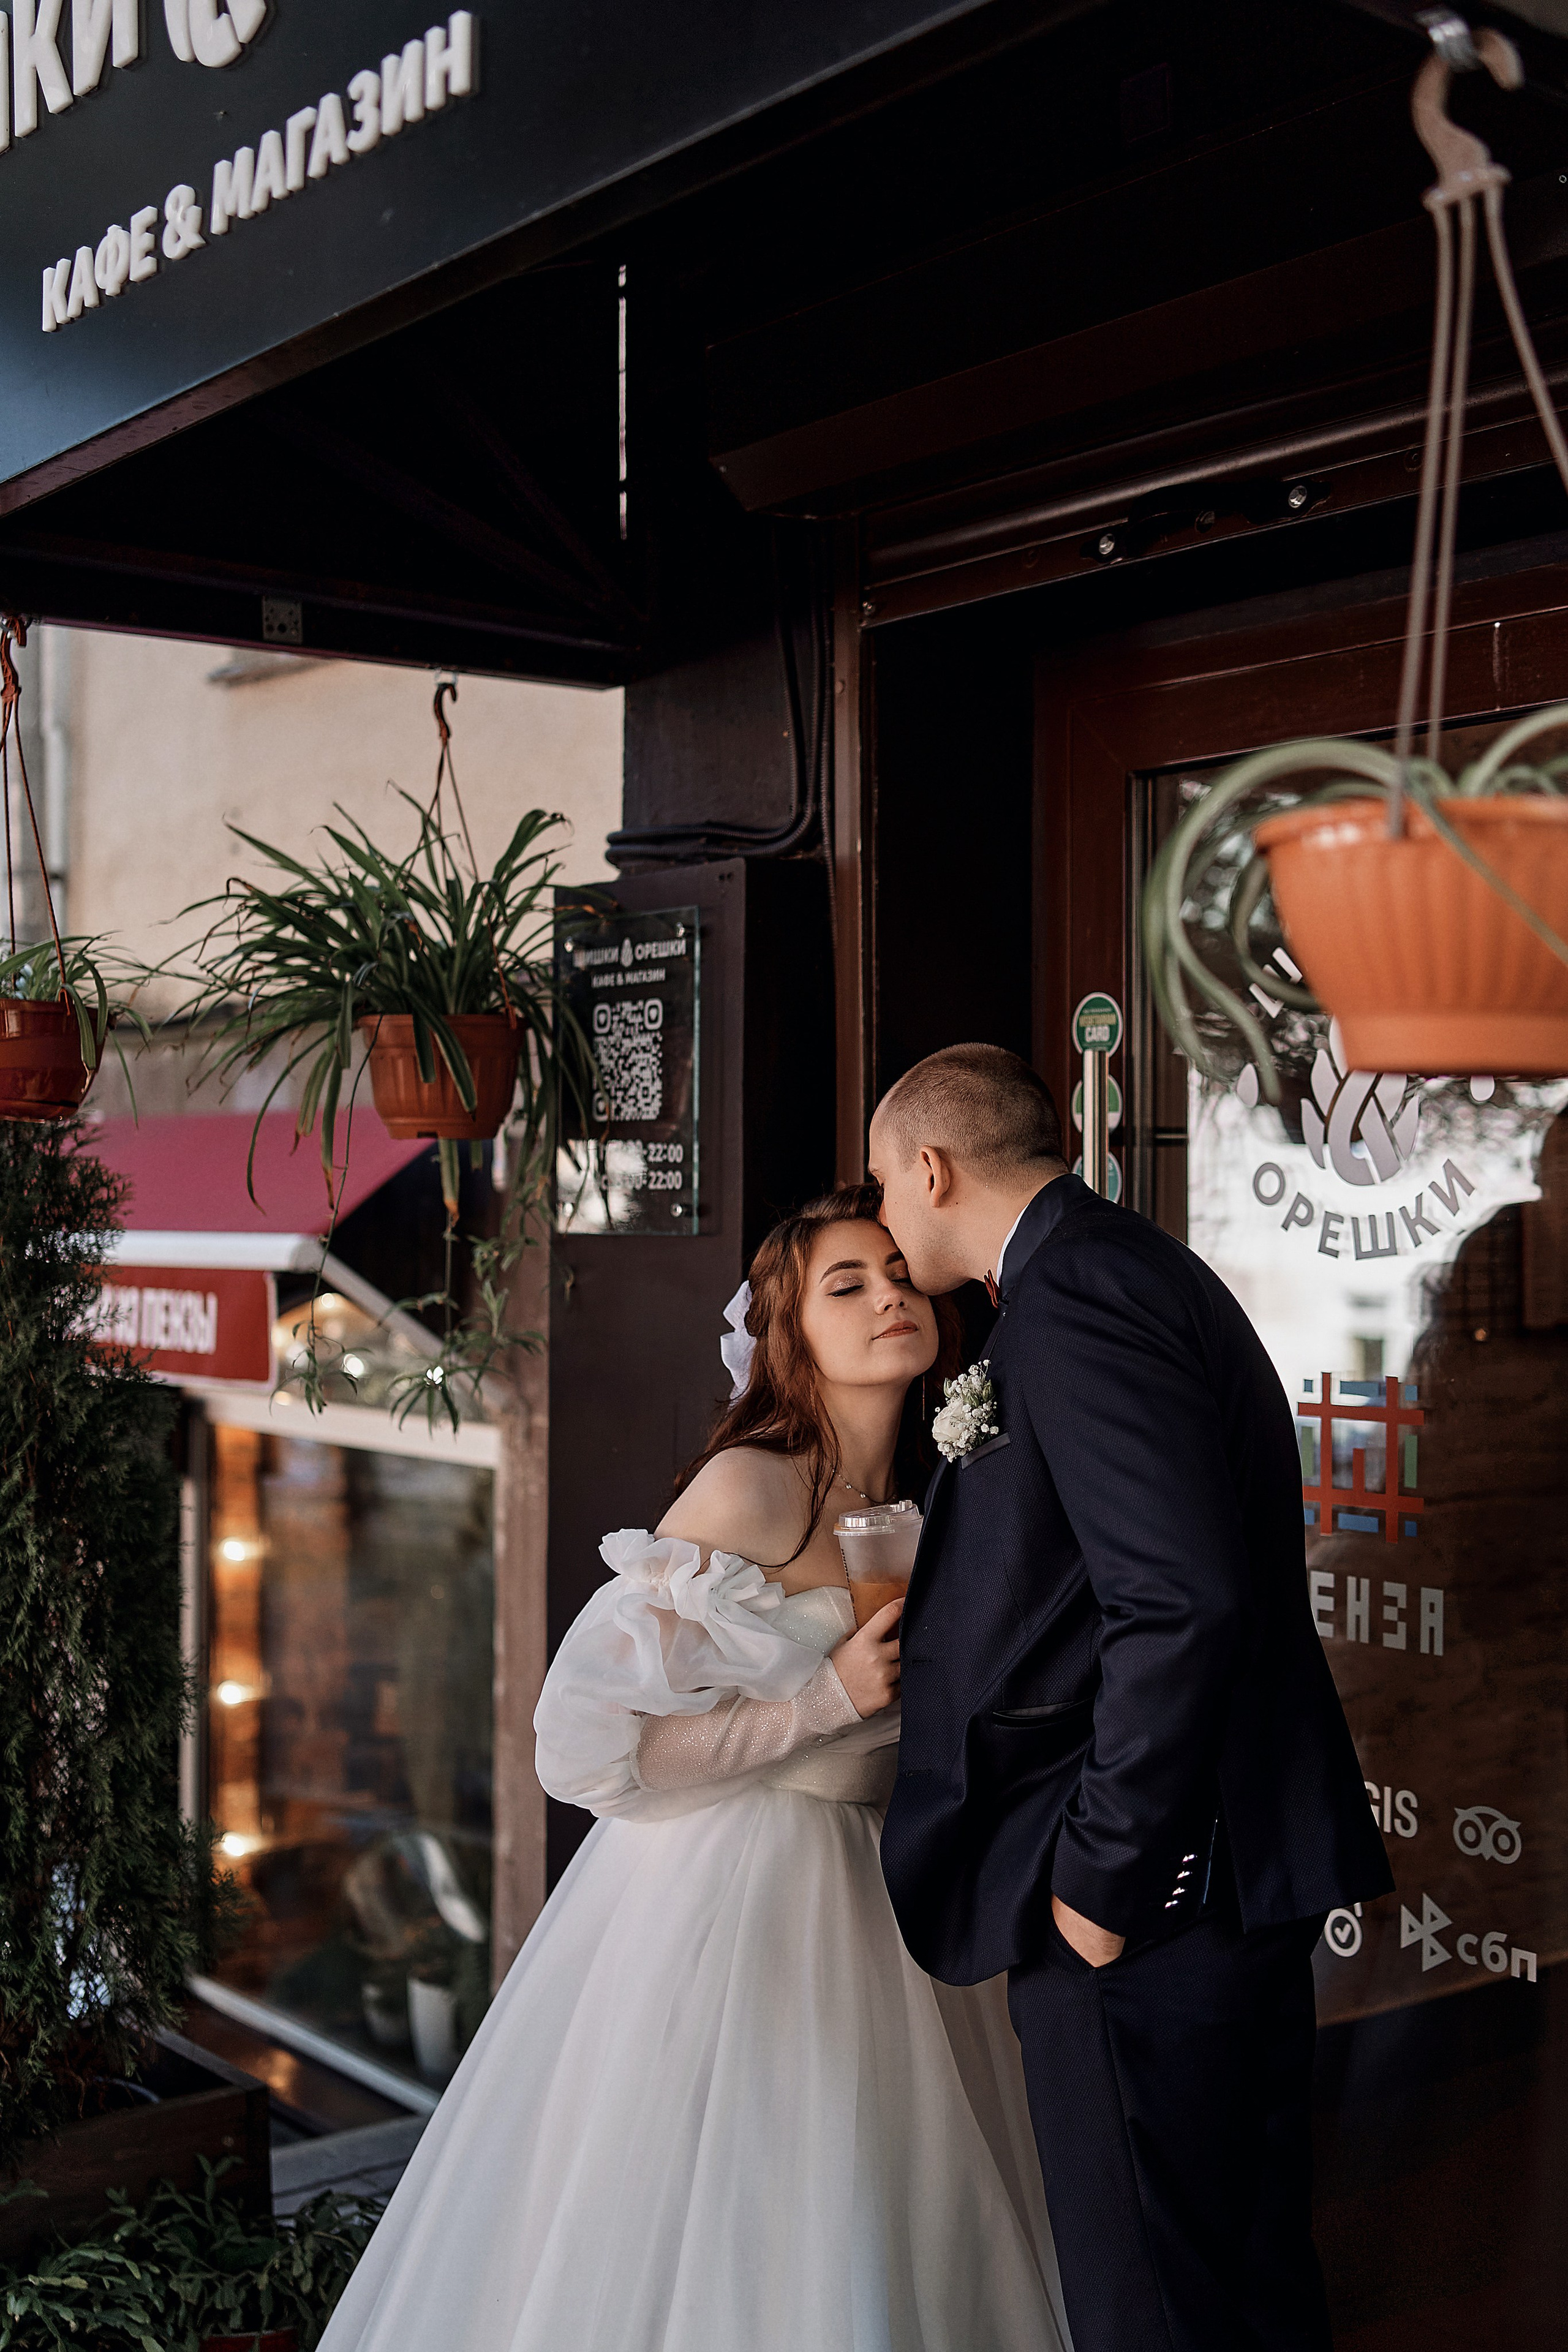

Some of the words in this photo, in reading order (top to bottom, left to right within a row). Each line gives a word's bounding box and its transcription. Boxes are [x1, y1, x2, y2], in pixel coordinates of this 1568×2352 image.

[42, 205, 158, 332] КАФЕ
[162, 184, 206, 260] &
[211, 10, 475, 235] МАГАЗИН
[635, 938, 687, 960] ОРЕШКИ
[591, 973, 615, 988] КАФЕ
[616, 971, 624, 986] &
[625, 967, 666, 984] МАГАЗИН
[1253, 1159, 1476, 1261] ОРЕШКИ
[1457, 1931, 1537, 1983] сбп
